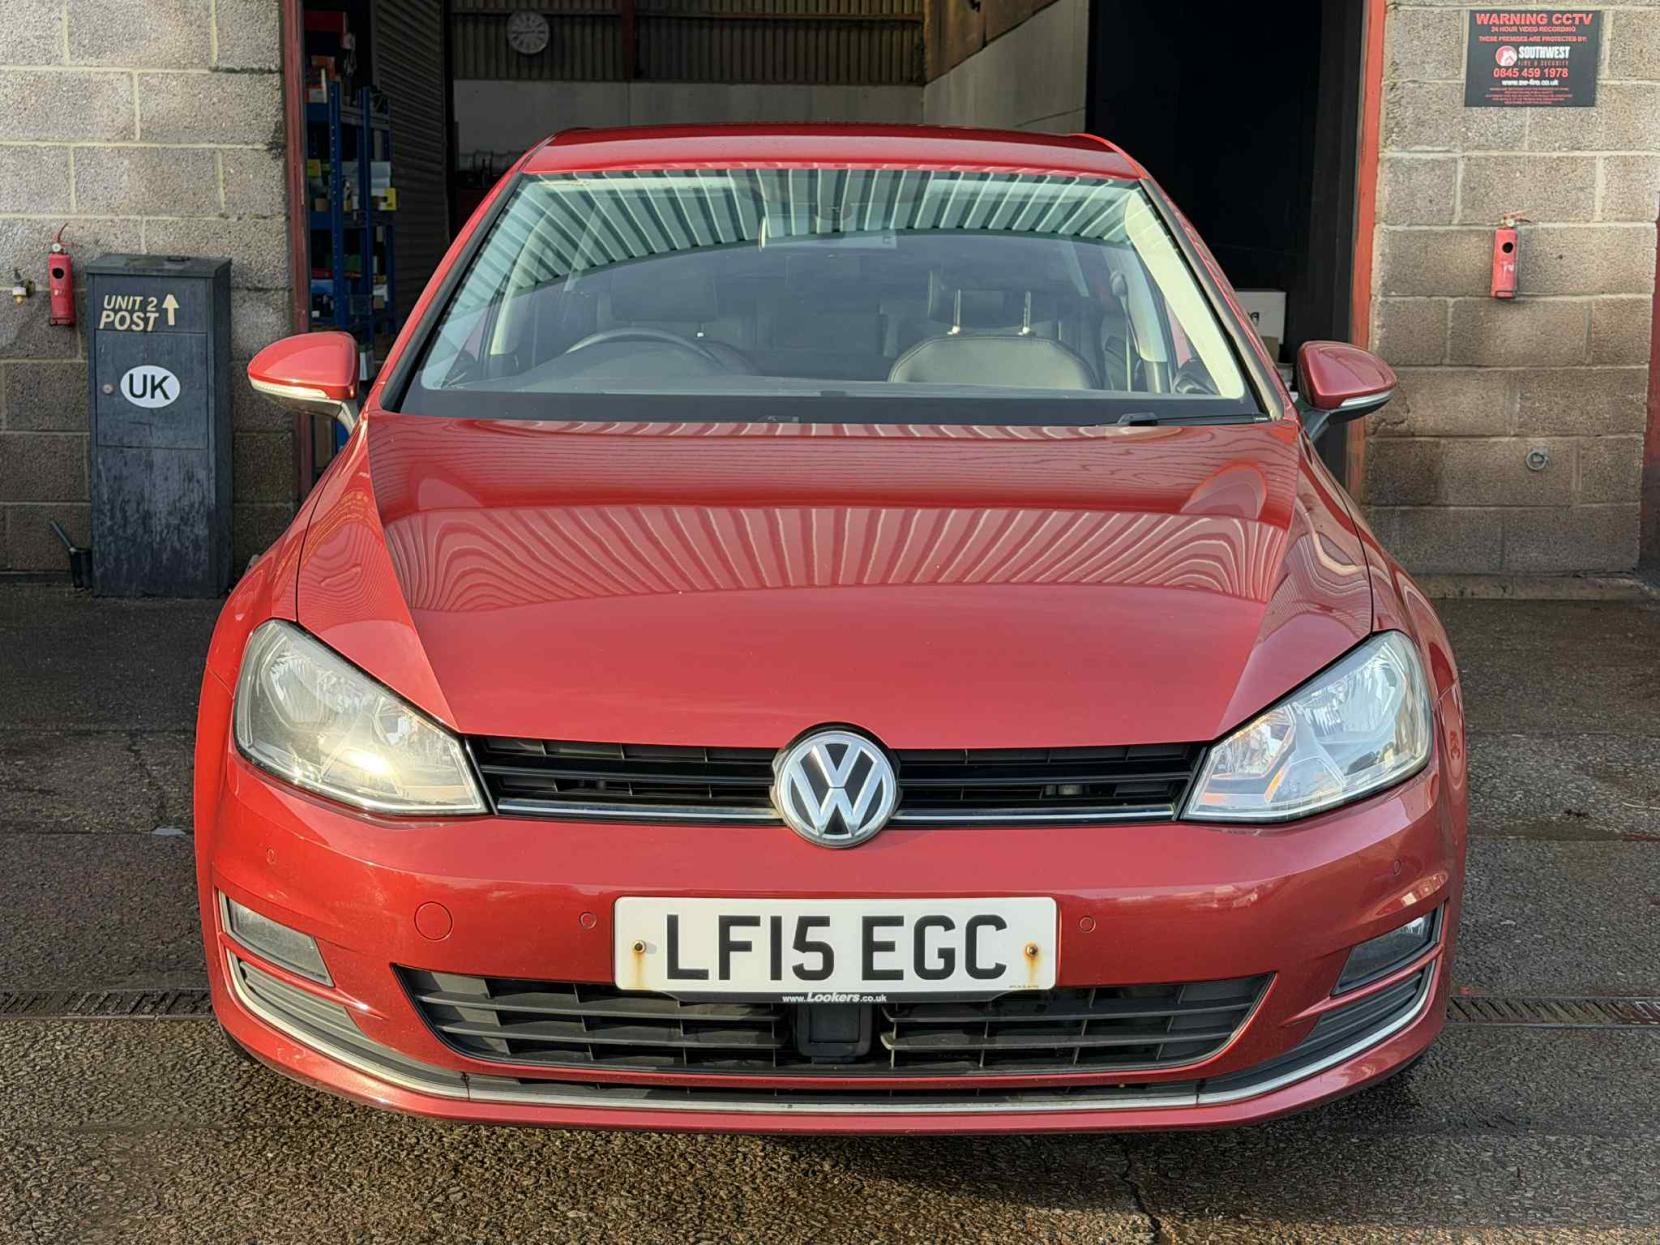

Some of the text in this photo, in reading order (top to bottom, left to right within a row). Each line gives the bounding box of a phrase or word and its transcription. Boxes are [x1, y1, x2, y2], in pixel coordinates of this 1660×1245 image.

[1476, 13, 1592, 25] WARNING CCTV
[1518, 46, 1570, 59] SOUTHWEST
[1493, 67, 1569, 78] 0845 459 1978
[103, 294, 158, 310] UNIT 2
[99, 311, 159, 331] POST
[128, 373, 171, 400] UK
[666, 914, 1008, 982] LF15 EGC
[782, 991, 887, 1003] www.Lookers.co.uk
